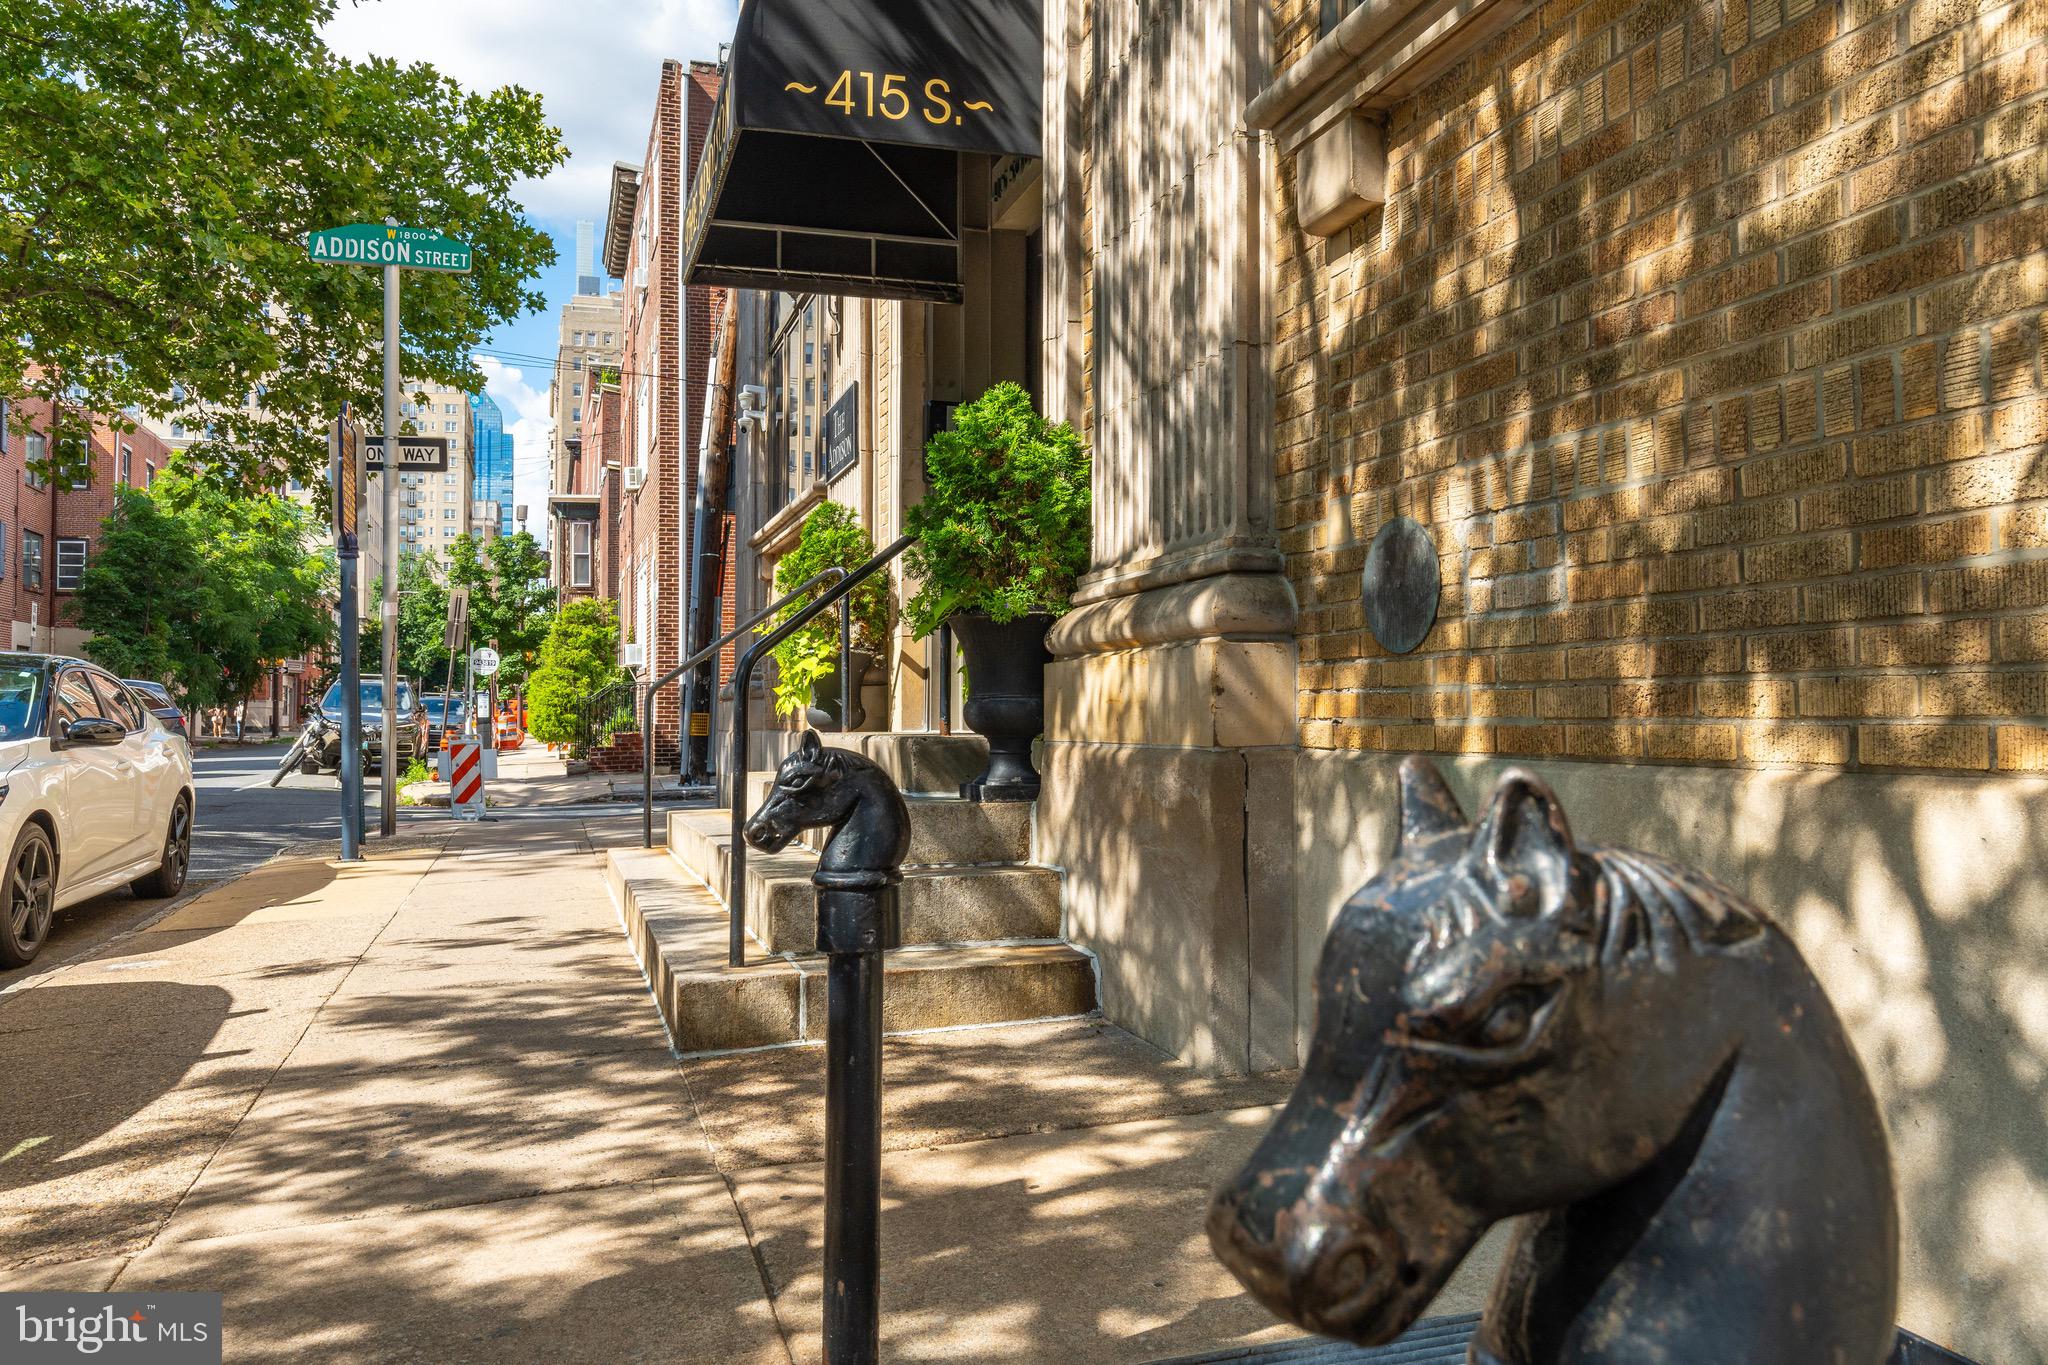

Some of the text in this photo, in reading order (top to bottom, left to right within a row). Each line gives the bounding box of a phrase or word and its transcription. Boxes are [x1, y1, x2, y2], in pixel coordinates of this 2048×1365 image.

[386, 228, 426, 240] W 1800
[314, 236, 468, 268] ADDISON STREET
[366, 447, 435, 462] ON WAY
